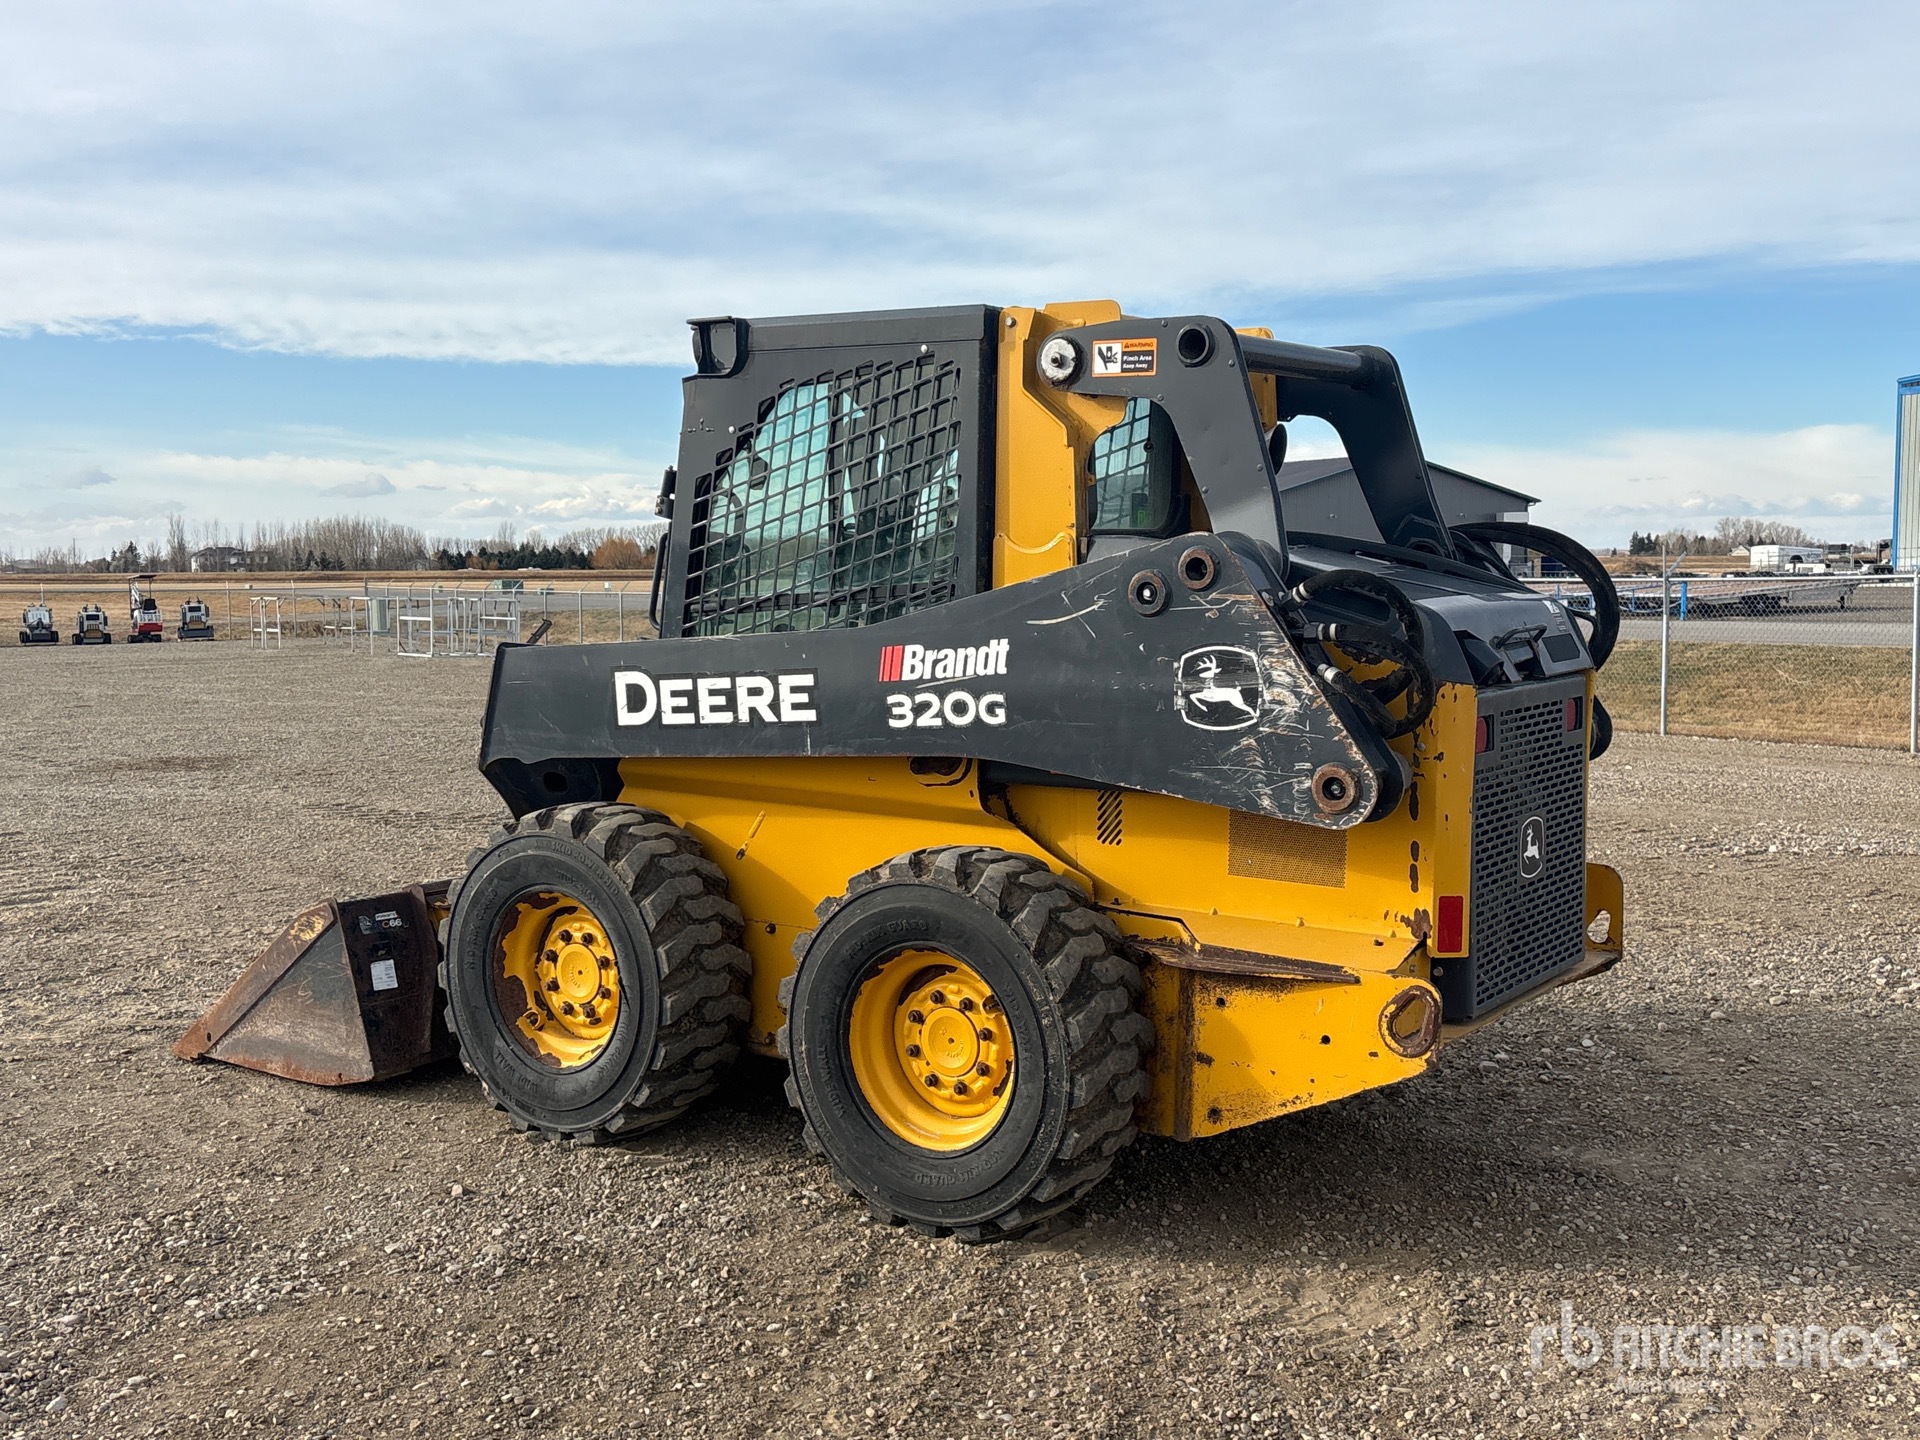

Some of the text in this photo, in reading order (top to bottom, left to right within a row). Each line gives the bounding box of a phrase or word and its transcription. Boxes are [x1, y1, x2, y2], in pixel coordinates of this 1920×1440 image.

[901, 639, 1009, 681] Brandt
[614, 671, 817, 727] DEERE
[887, 694, 1006, 728] 320G
